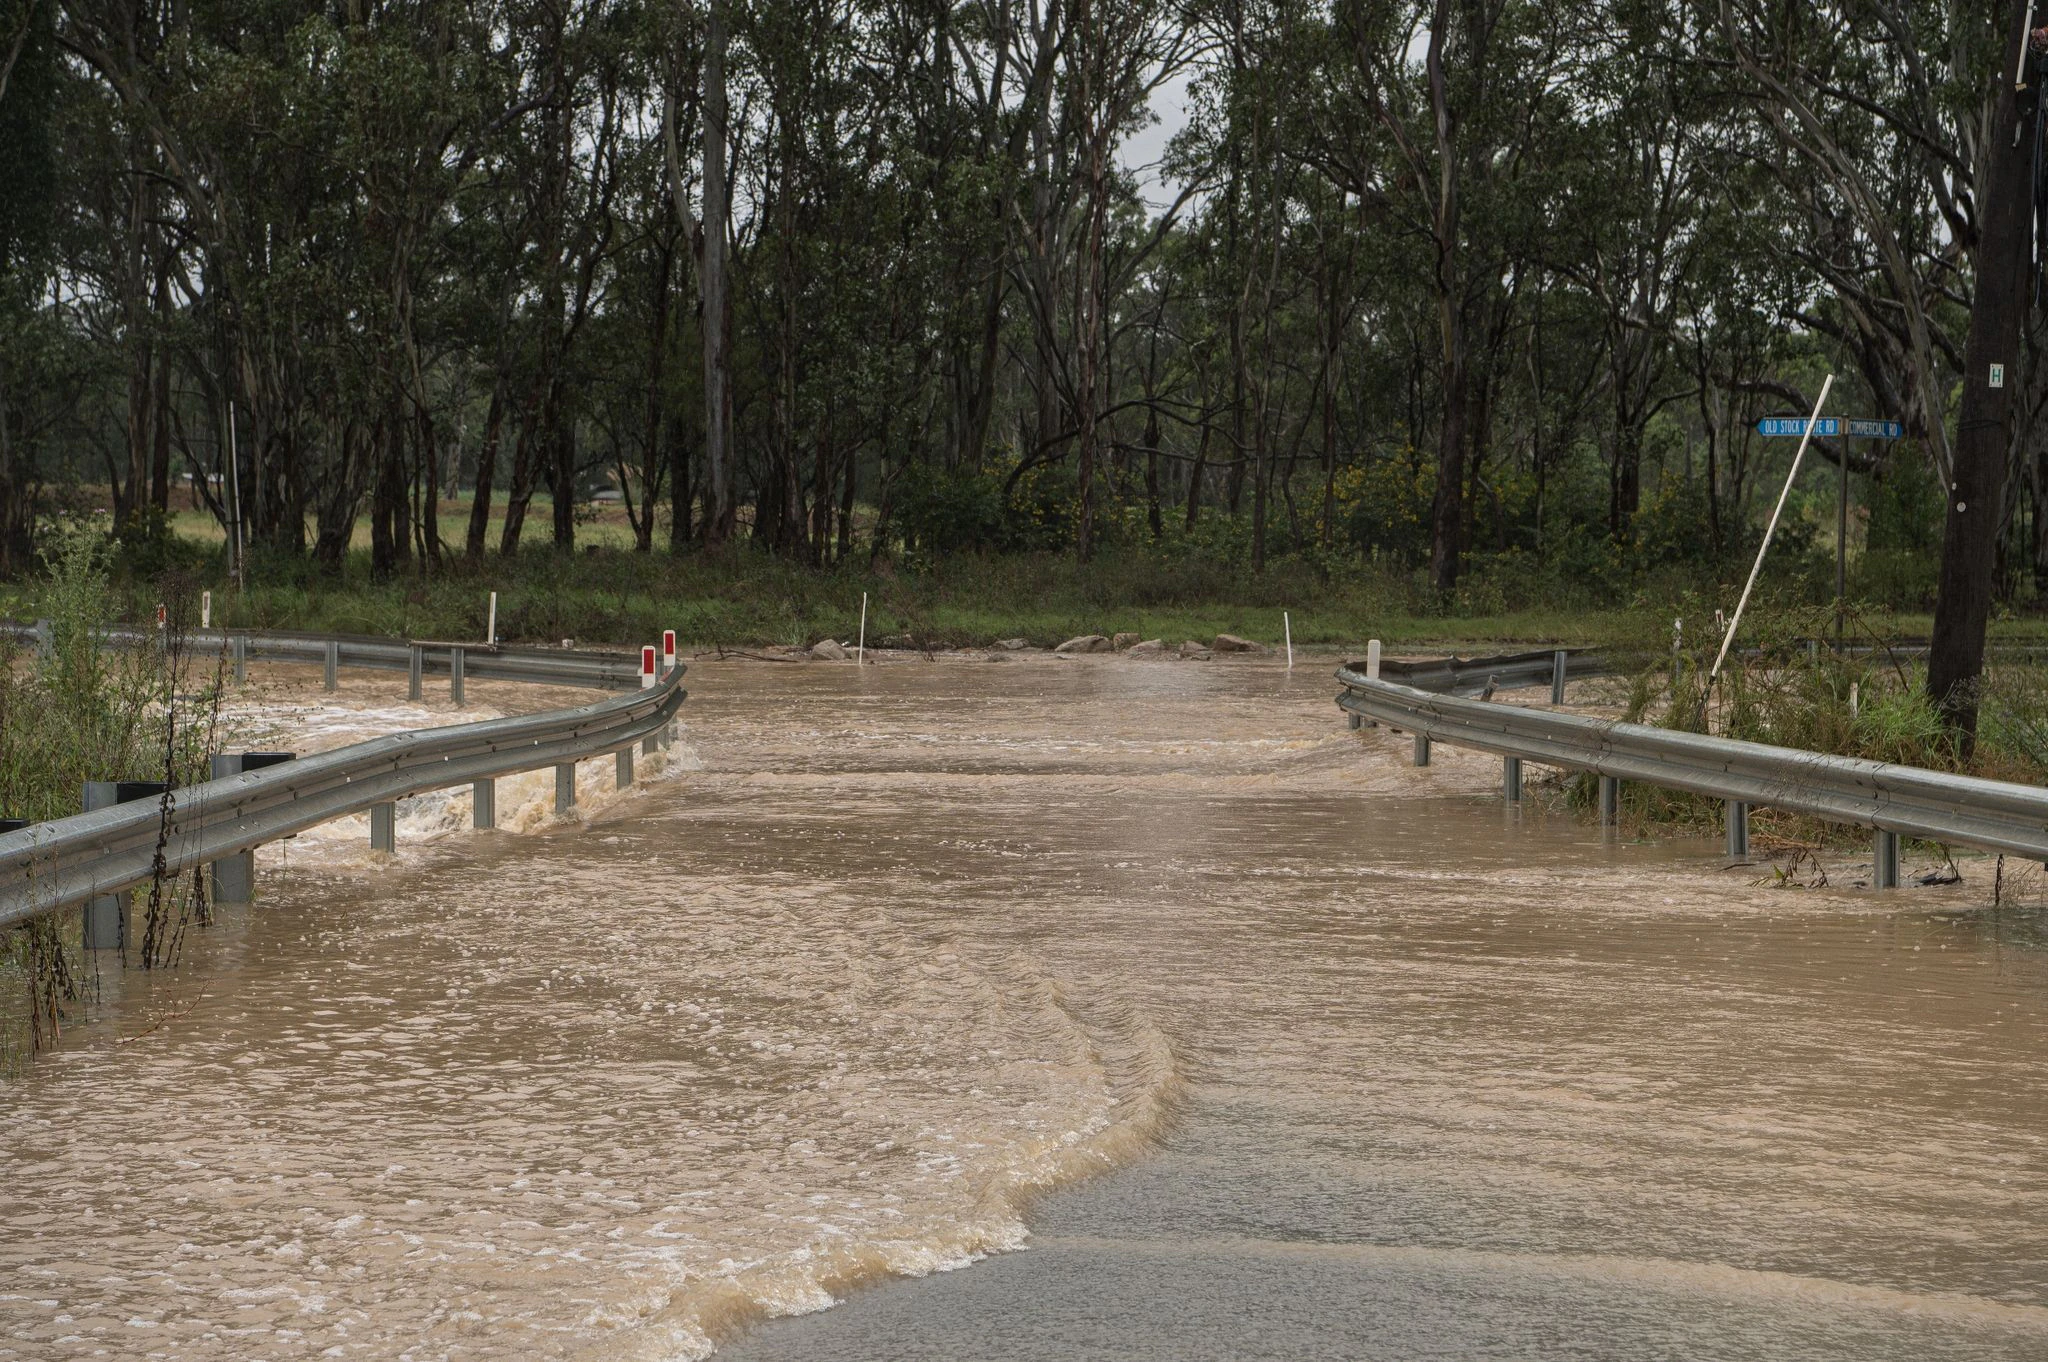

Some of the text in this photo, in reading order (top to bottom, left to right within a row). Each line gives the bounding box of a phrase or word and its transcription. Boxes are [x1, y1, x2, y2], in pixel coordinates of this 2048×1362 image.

[1992, 368, 2001, 382] H
[1765, 420, 1835, 433] OLD STOCK RTE RD
[1849, 420, 1898, 437] COMMERCIAL RD
